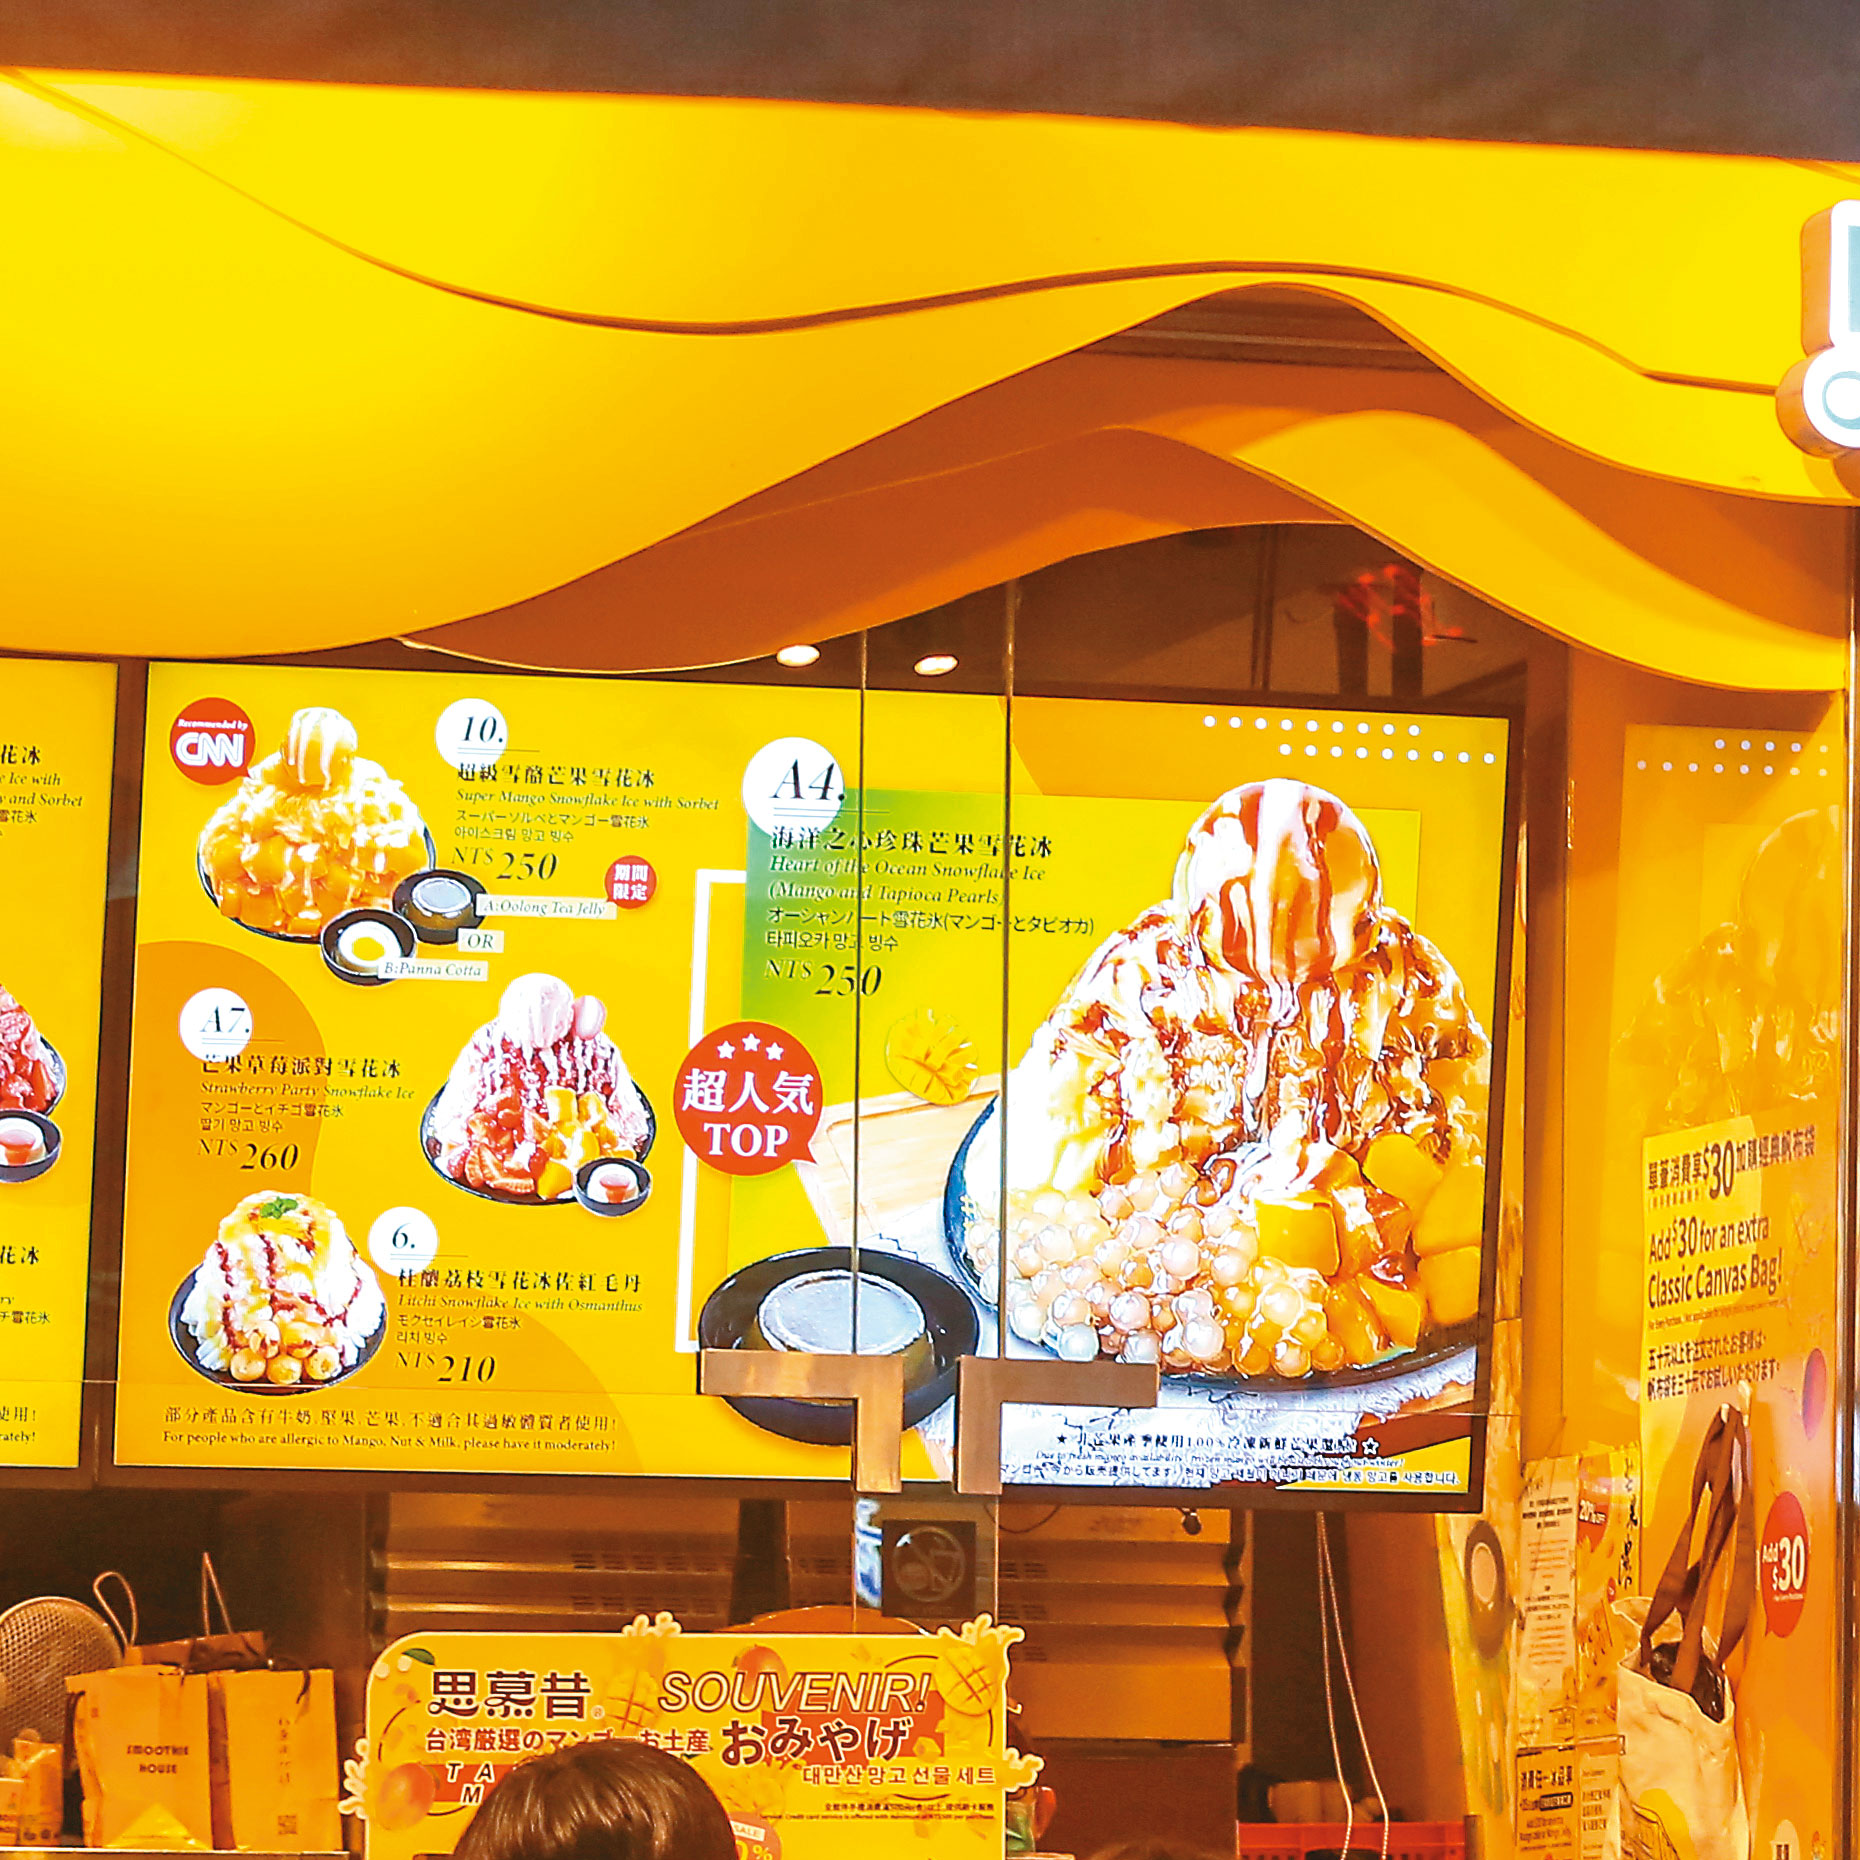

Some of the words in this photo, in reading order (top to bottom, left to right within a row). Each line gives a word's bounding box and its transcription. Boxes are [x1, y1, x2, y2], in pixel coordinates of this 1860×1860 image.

[461, 716, 504, 743] 10.
[176, 732, 244, 767] CNN
[769, 758, 845, 801] A4.
[456, 790, 494, 804] Super
[499, 790, 545, 808] Mango
[550, 792, 619, 809] Snowflake
[621, 795, 639, 808] Ice
[643, 796, 672, 809] with
[676, 797, 719, 811] Sorbet
[614, 864, 648, 882] 期間
[770, 855, 818, 873] Heart
[875, 860, 928, 877] Ocean
[1022, 866, 1046, 881] Ice
[613, 882, 648, 901] 限定
[768, 880, 834, 901] (Mango
[880, 886, 942, 904] Tapioca
[551, 901, 573, 914] Tea
[576, 902, 606, 918] Jelly
[467, 934, 494, 949] OR
[766, 931, 828, 950] 타피오카
[869, 934, 899, 950] 빙수
[445, 963, 481, 976] Cotta
[199, 1004, 250, 1033] A7.
[201, 1080, 277, 1097] Strawberry
[281, 1083, 319, 1097] Party
[324, 1084, 392, 1101] Snowflake
[396, 1086, 415, 1100] Ice
[682, 1068, 814, 1115] 超人気
[703, 1122, 789, 1157] TOP
[392, 1222, 416, 1249] 6.
[1699, 1219, 1717, 1251] for
[1720, 1222, 1735, 1249] an
[1738, 1213, 1769, 1244] extra
[1648, 1265, 1692, 1309] Classic
[1696, 1263, 1747, 1299] Canvas
[1750, 1247, 1782, 1296] Bag!
[398, 1294, 437, 1307] Litchi
[441, 1295, 509, 1311] Snowflake
[513, 1297, 532, 1309] Ice
[535, 1299, 565, 1311] with
[568, 1299, 642, 1312] Osmanthus
[164, 1431, 183, 1443] For
[187, 1432, 227, 1446] people
[231, 1433, 255, 1444] who
[258, 1435, 277, 1445] are
[280, 1433, 323, 1447] allergic
[327, 1434, 339, 1445] to
[391, 1436, 412, 1447] Nut
[464, 1437, 500, 1450] please
[503, 1438, 530, 1449] have
[533, 1438, 542, 1449] it
[544, 1439, 616, 1452] moderately!
[427, 1671, 592, 1719] 思慕昔
[657, 1670, 932, 1713] SOUVENIR!
[127, 1745, 188, 1755] SMOOTHIE
[721, 1716, 912, 1765] おみやげ
[139, 1764, 177, 1773] HOUSE
[803, 1765, 865, 1785] 대만산
[868, 1767, 907, 1785] 망고
[912, 1767, 952, 1785] 선물
[956, 1768, 996, 1785] 세트
